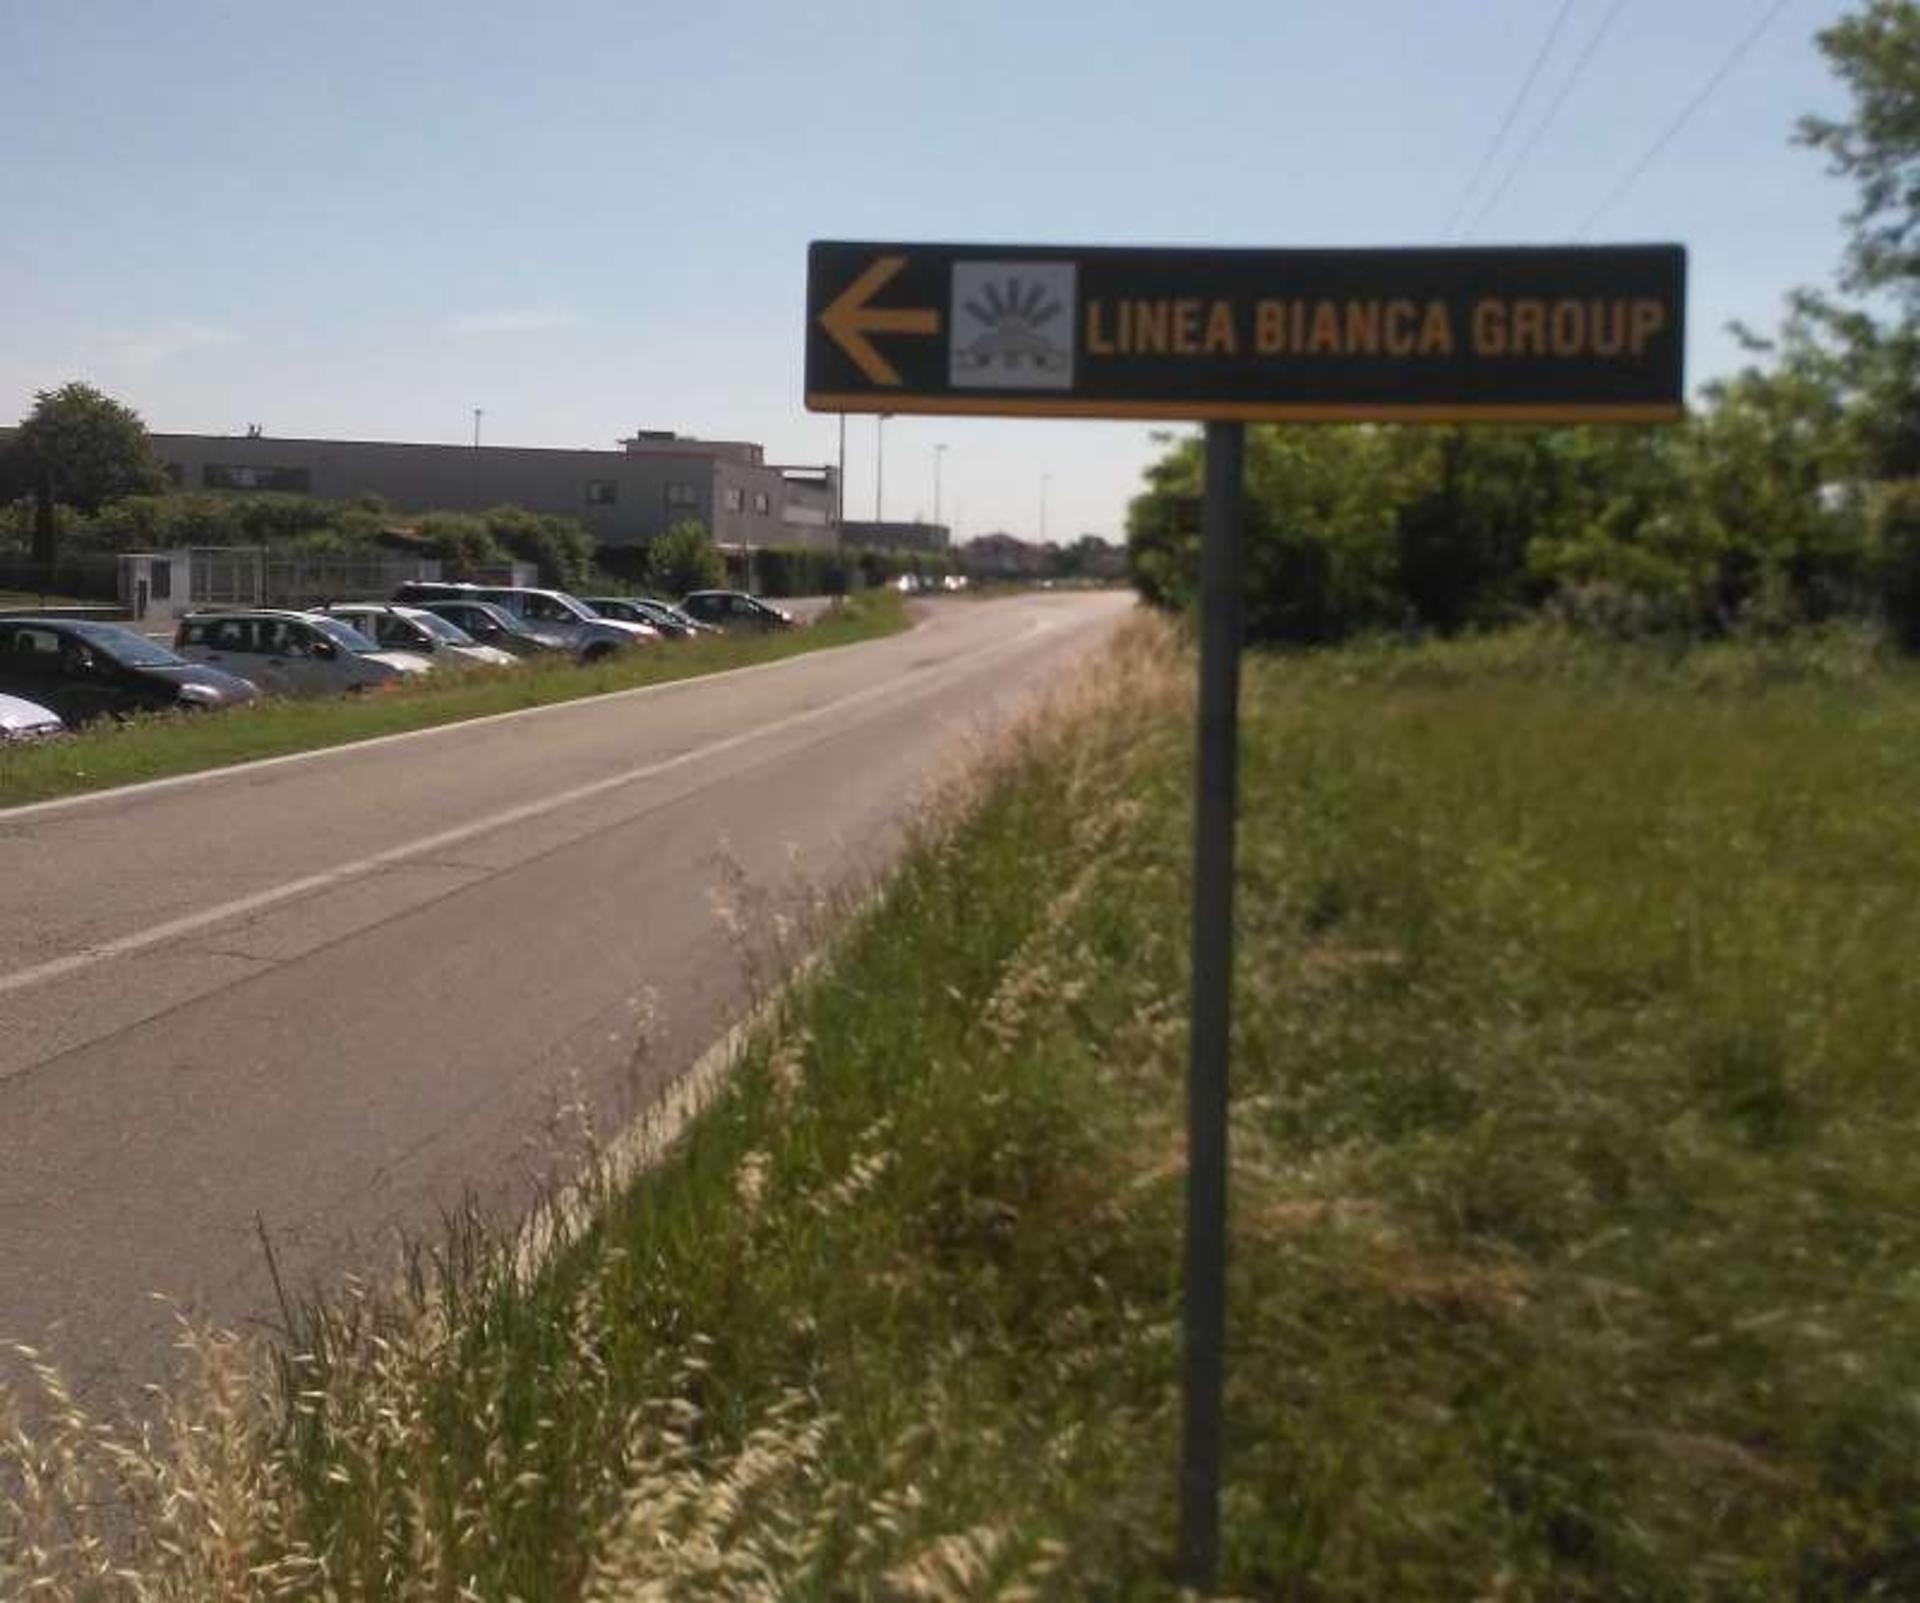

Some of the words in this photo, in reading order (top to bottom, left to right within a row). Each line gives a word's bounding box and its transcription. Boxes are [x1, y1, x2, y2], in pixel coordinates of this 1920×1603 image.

[1087, 300, 1238, 355] LINEA
[1256, 300, 1451, 356] BIANCA
[1473, 299, 1663, 358] GROUP
